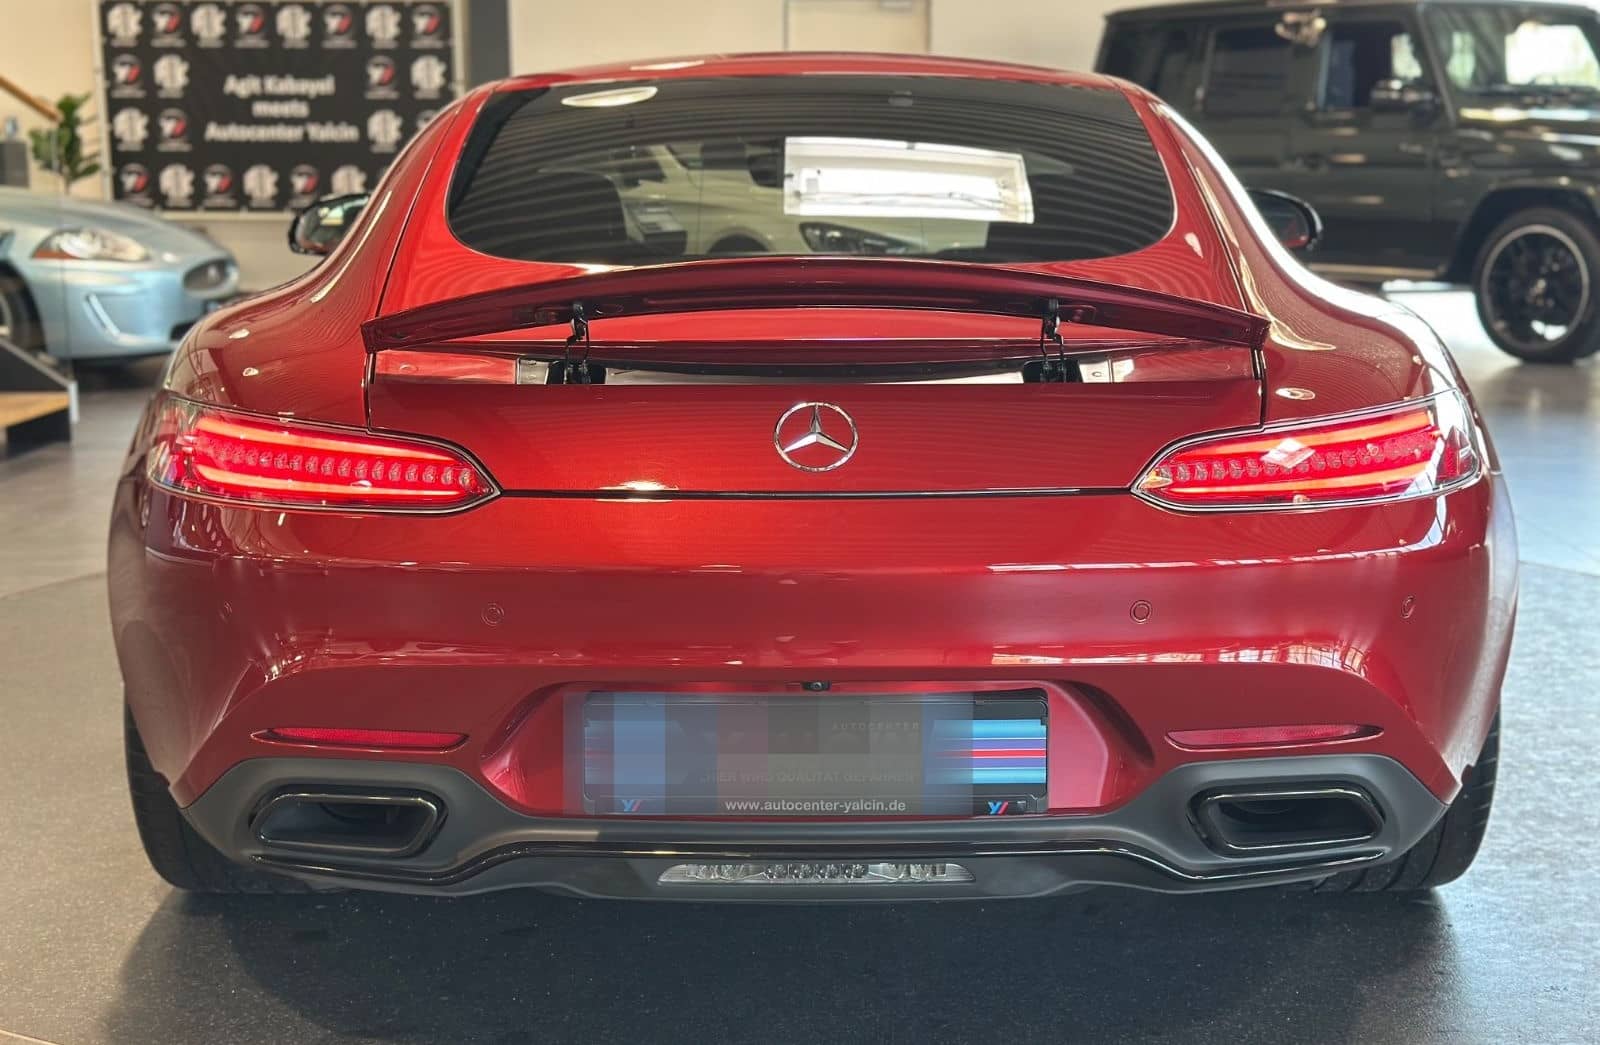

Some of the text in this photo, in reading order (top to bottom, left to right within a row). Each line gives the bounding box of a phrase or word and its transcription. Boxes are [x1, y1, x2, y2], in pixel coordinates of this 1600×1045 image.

[205, 122, 360, 142] Autocenter Yalcin
[724, 799, 907, 814] www.autocenter-yalcin.de
